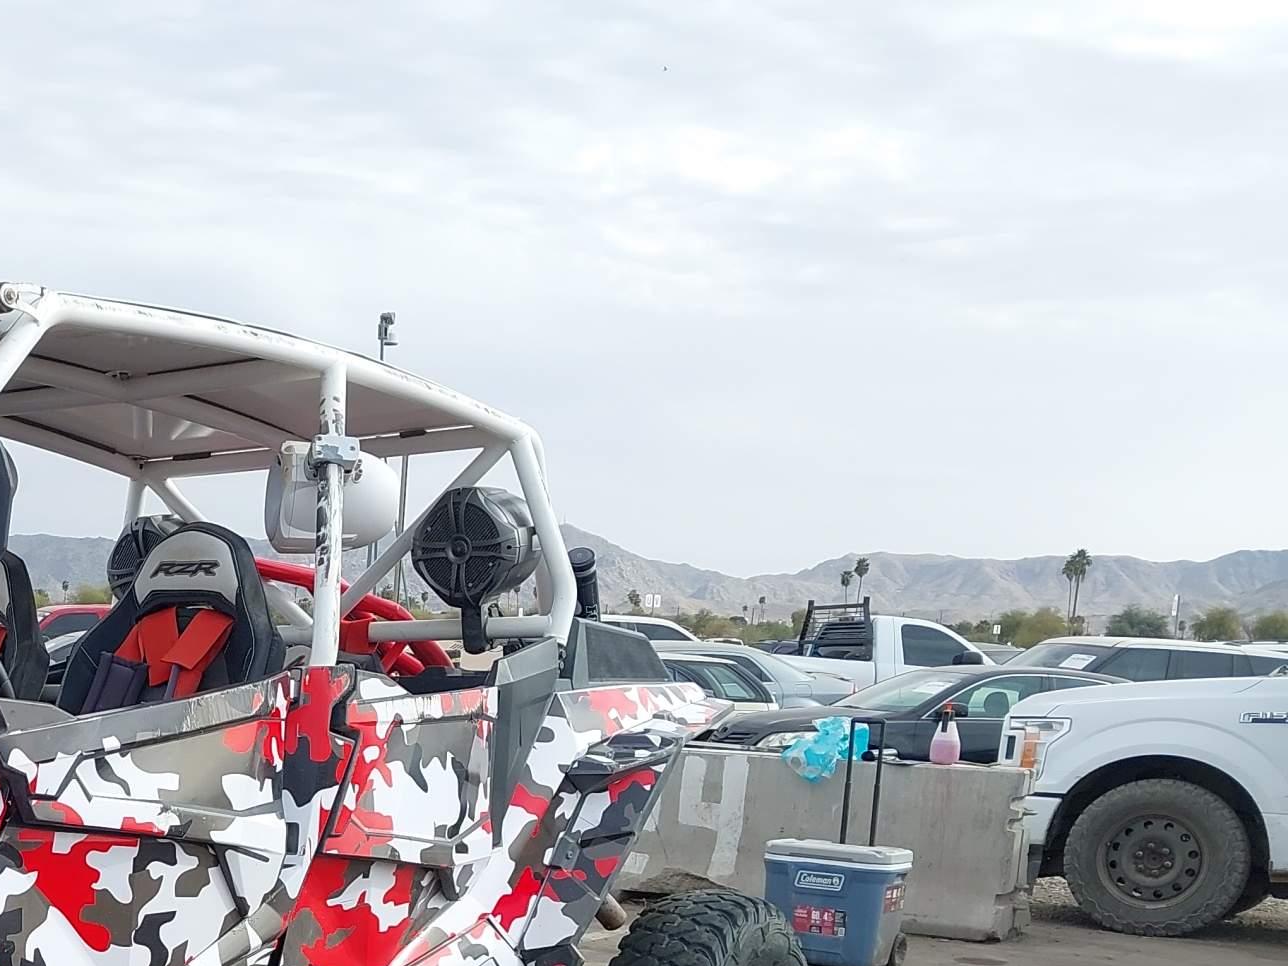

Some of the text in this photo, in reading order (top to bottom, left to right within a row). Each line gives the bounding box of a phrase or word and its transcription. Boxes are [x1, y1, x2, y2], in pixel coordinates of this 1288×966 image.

[149, 559, 220, 579] RZR
[1239, 711, 1288, 723] F15
[800, 872, 832, 886] Coleman
